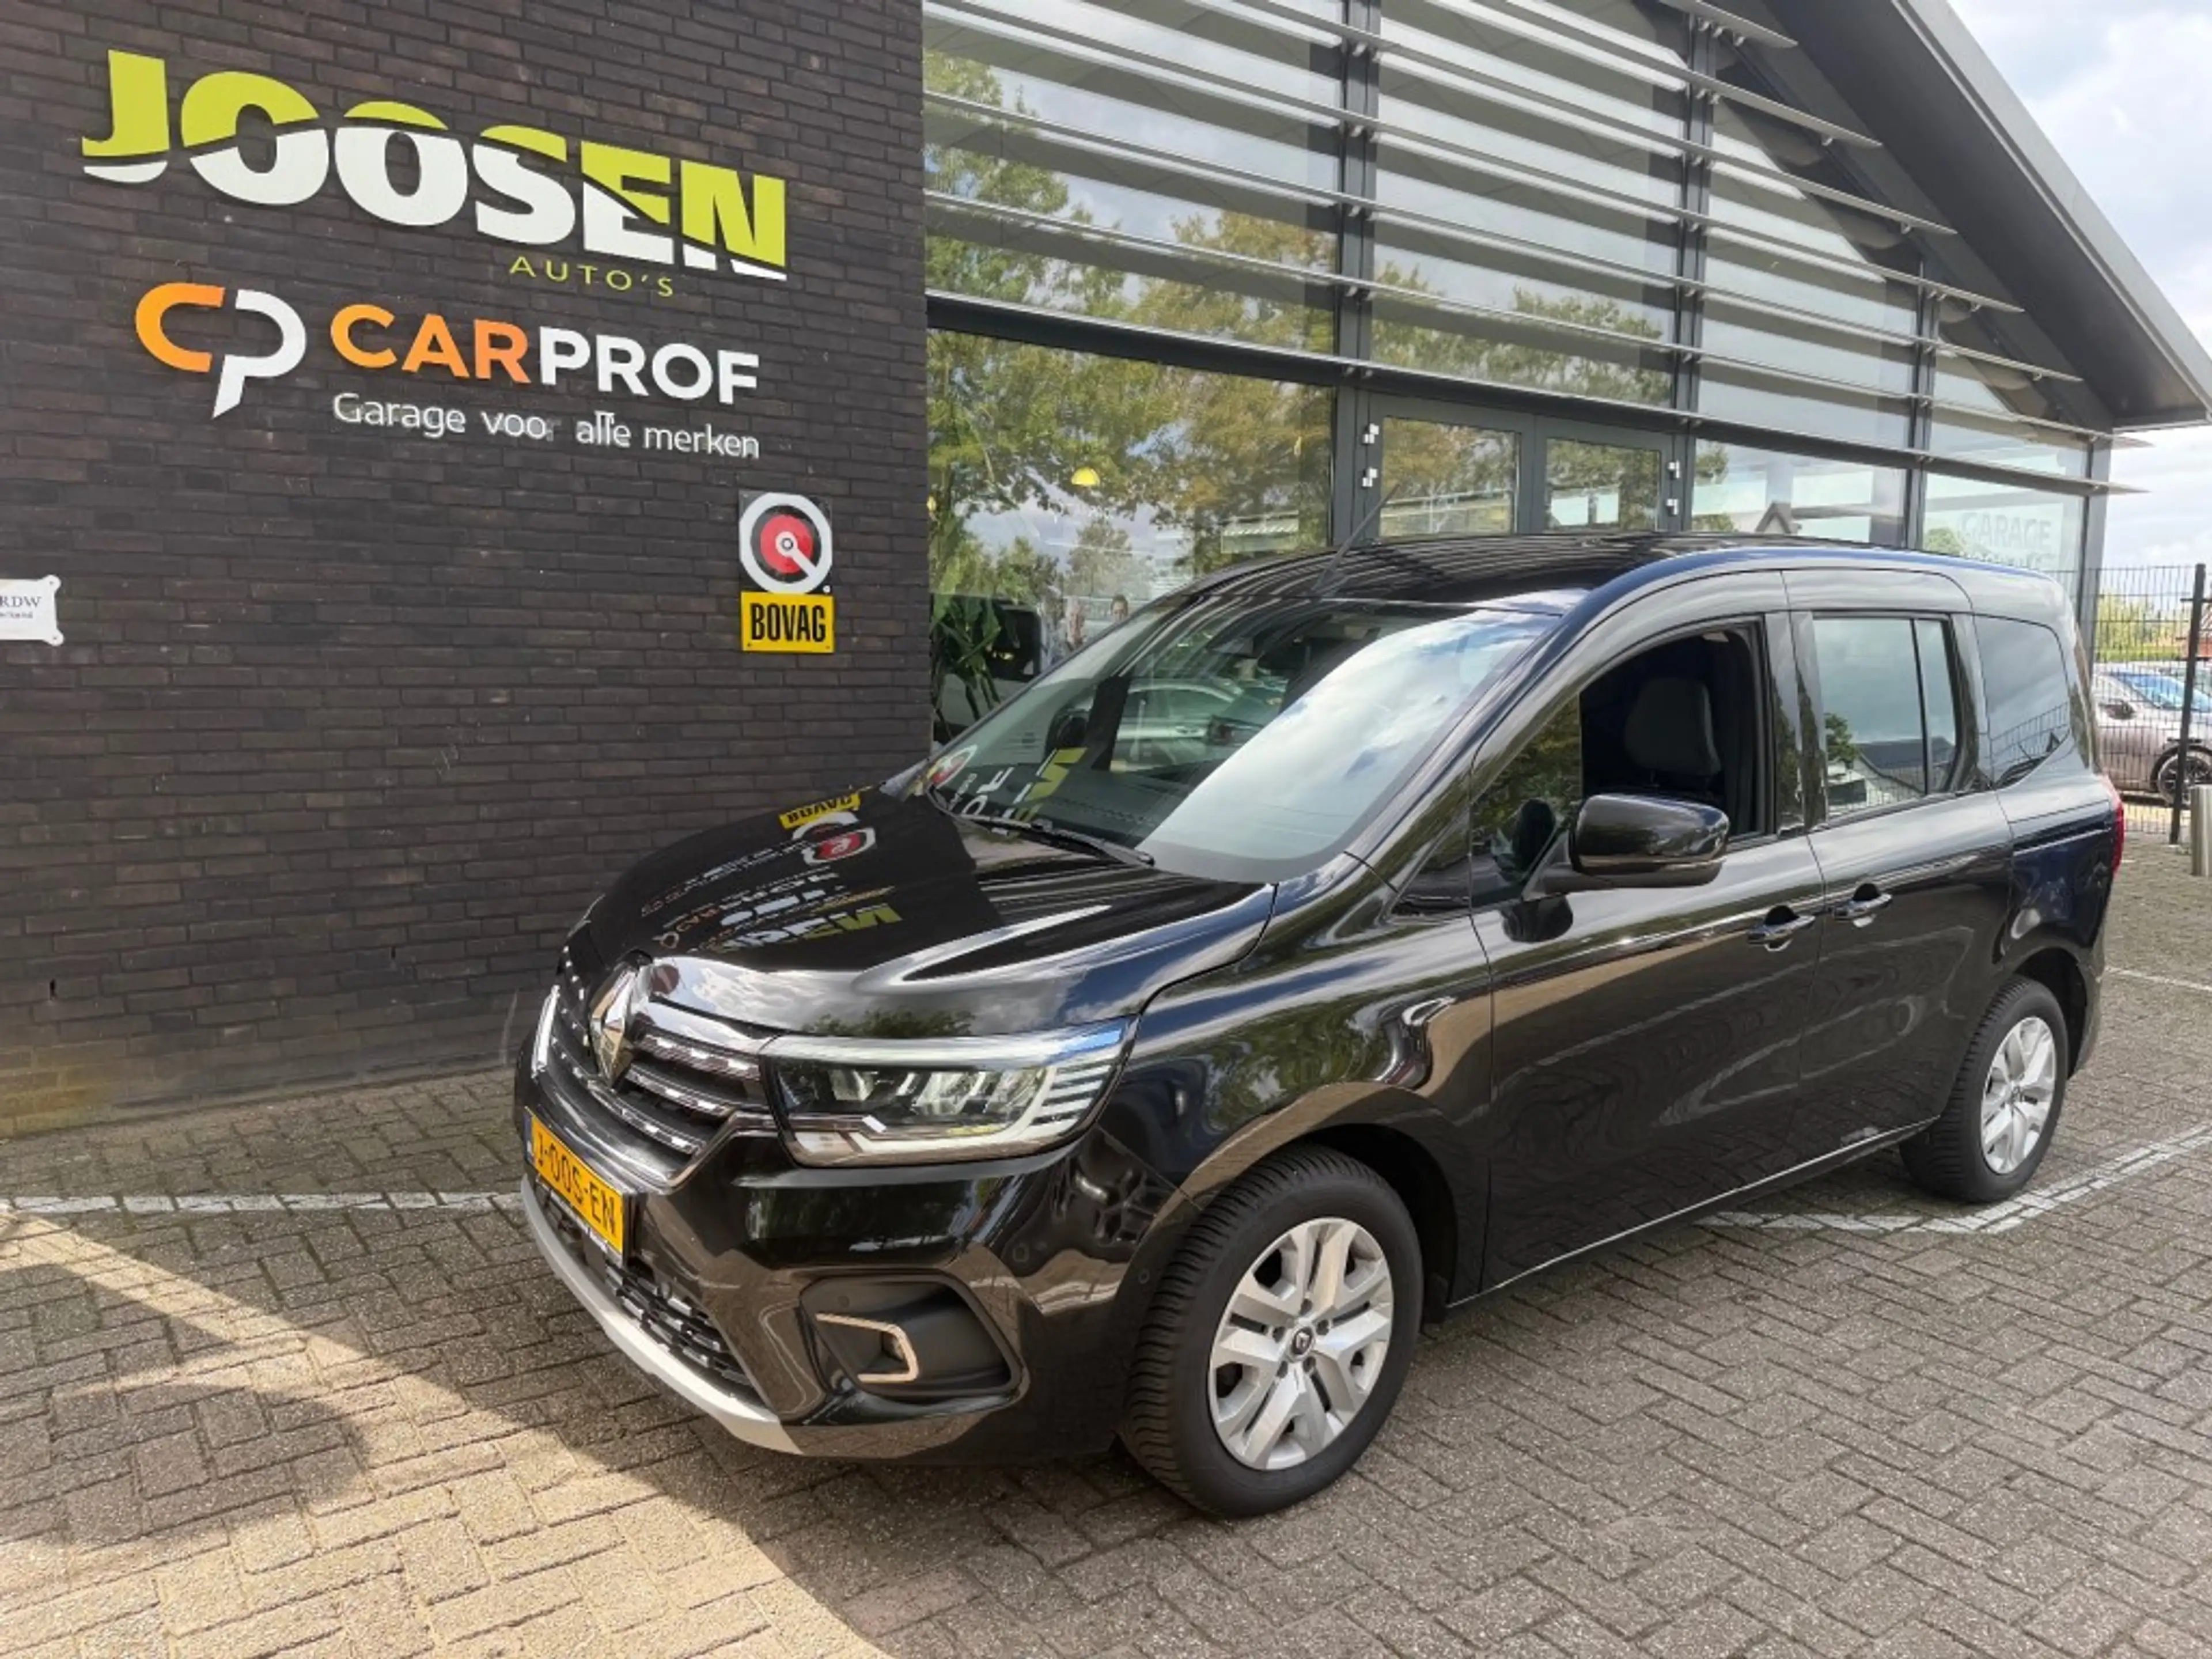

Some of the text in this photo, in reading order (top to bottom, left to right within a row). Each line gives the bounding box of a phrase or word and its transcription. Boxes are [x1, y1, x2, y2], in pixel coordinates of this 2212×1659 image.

[82, 50, 787, 281] JOOSEN
[509, 256, 673, 297] AUTO'S
[329, 304, 760, 404] CARPROF
[332, 393, 467, 438] Garage
[643, 424, 760, 460] merken
[0, 596, 42, 608] RDW
[750, 603, 826, 642] BOVAG
